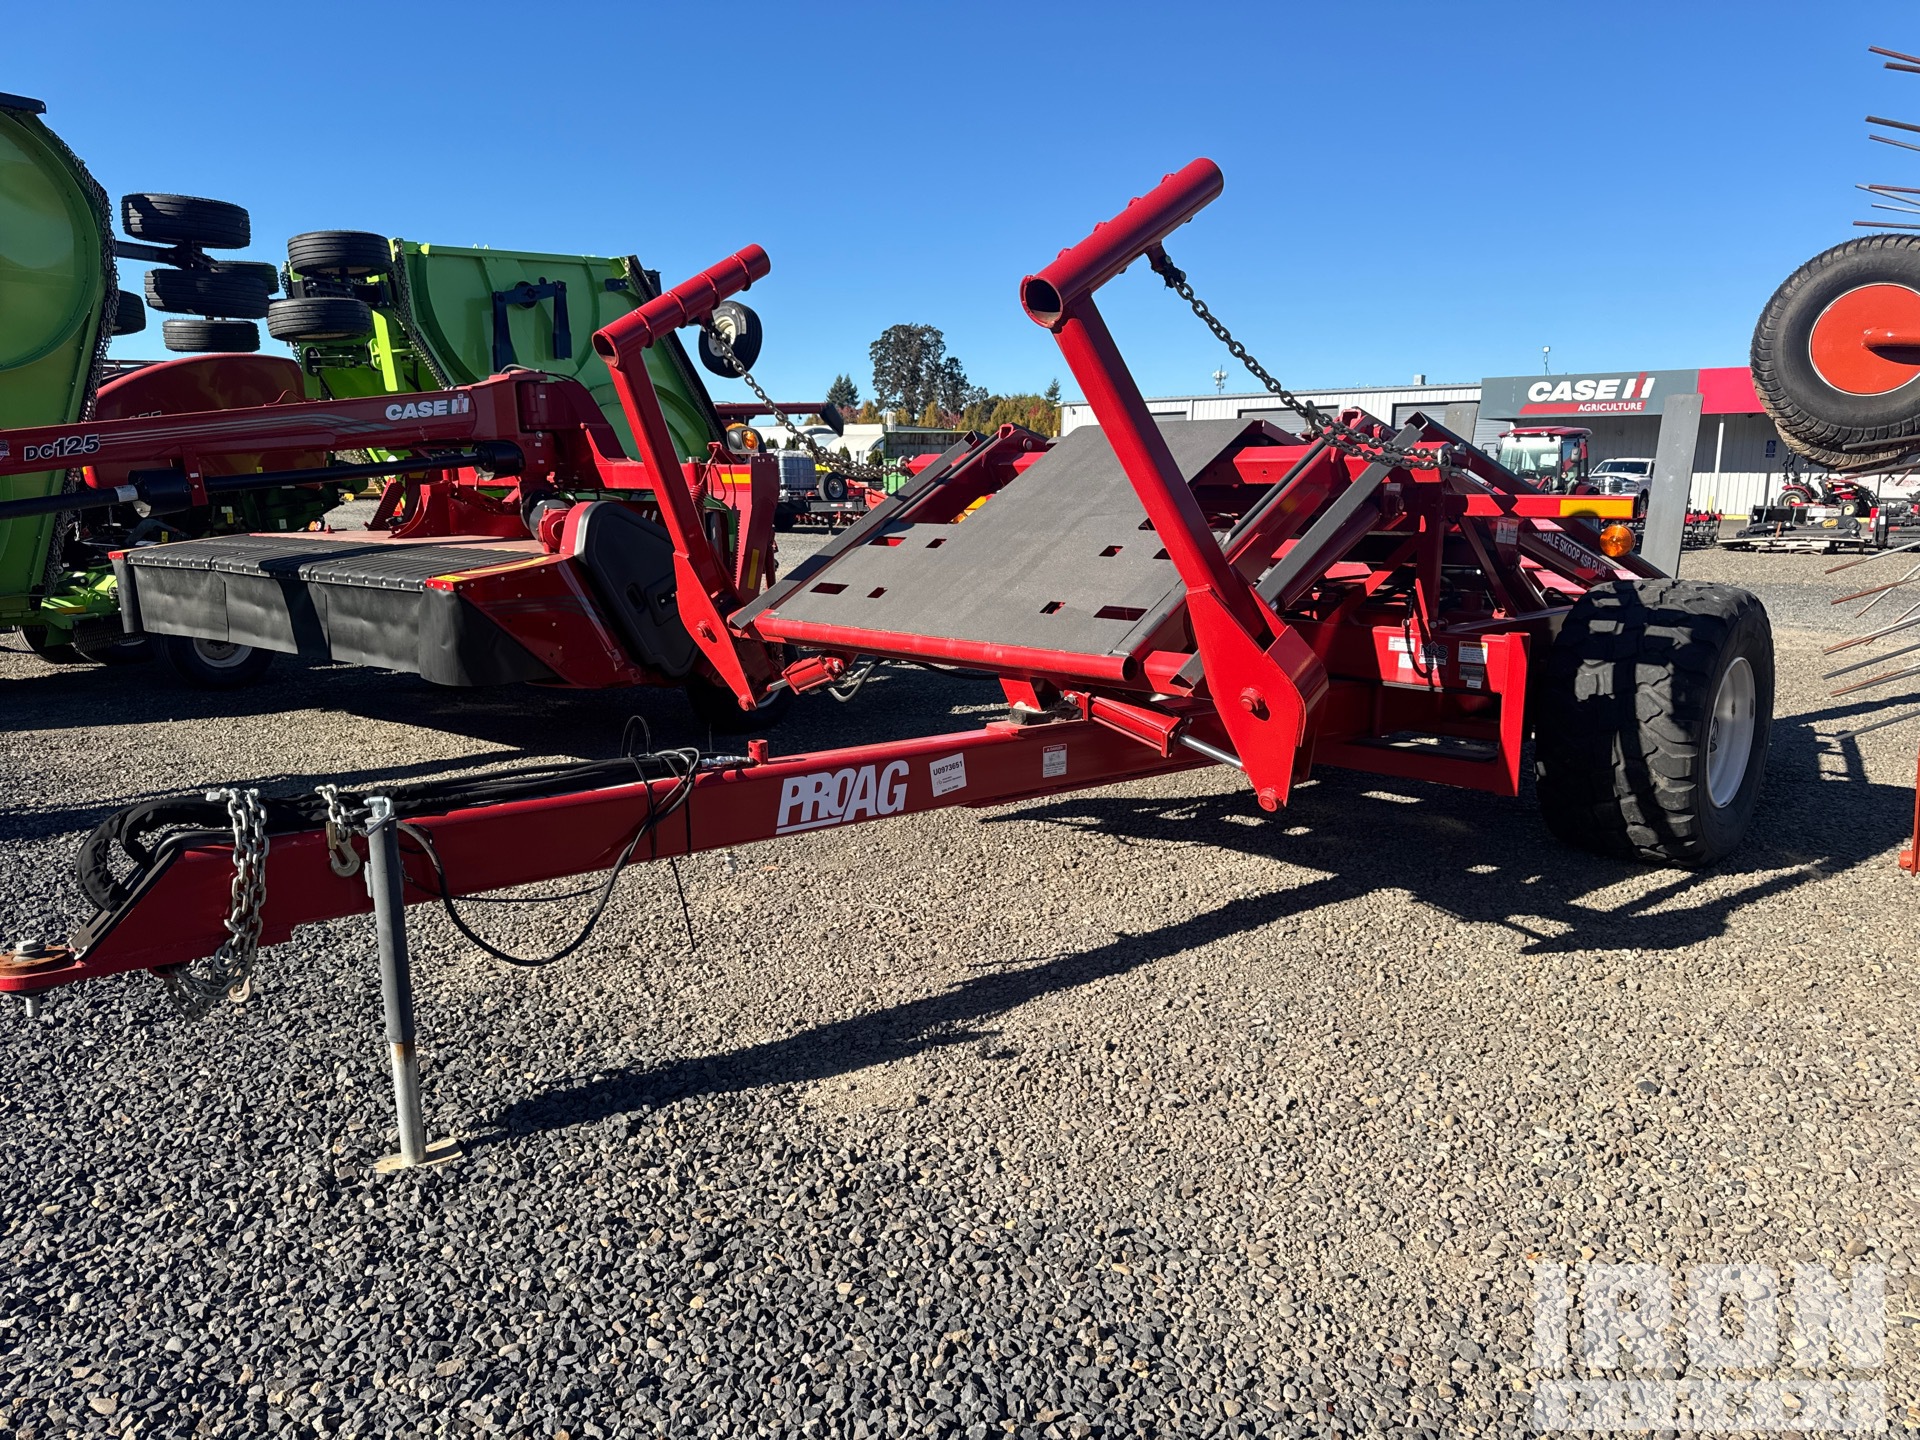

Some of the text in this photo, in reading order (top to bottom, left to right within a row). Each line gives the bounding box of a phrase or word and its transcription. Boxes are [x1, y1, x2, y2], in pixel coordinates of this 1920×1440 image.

[1528, 379, 1621, 402] CASE
[385, 400, 448, 421] CASE
[1577, 402, 1642, 412] AGRICULTURE
[24, 434, 100, 461] DC125
[1542, 532, 1560, 549] BALE
[1560, 540, 1580, 561] SKOOP
[1592, 560, 1607, 578] PLUS
[933, 760, 963, 776] U0973651
